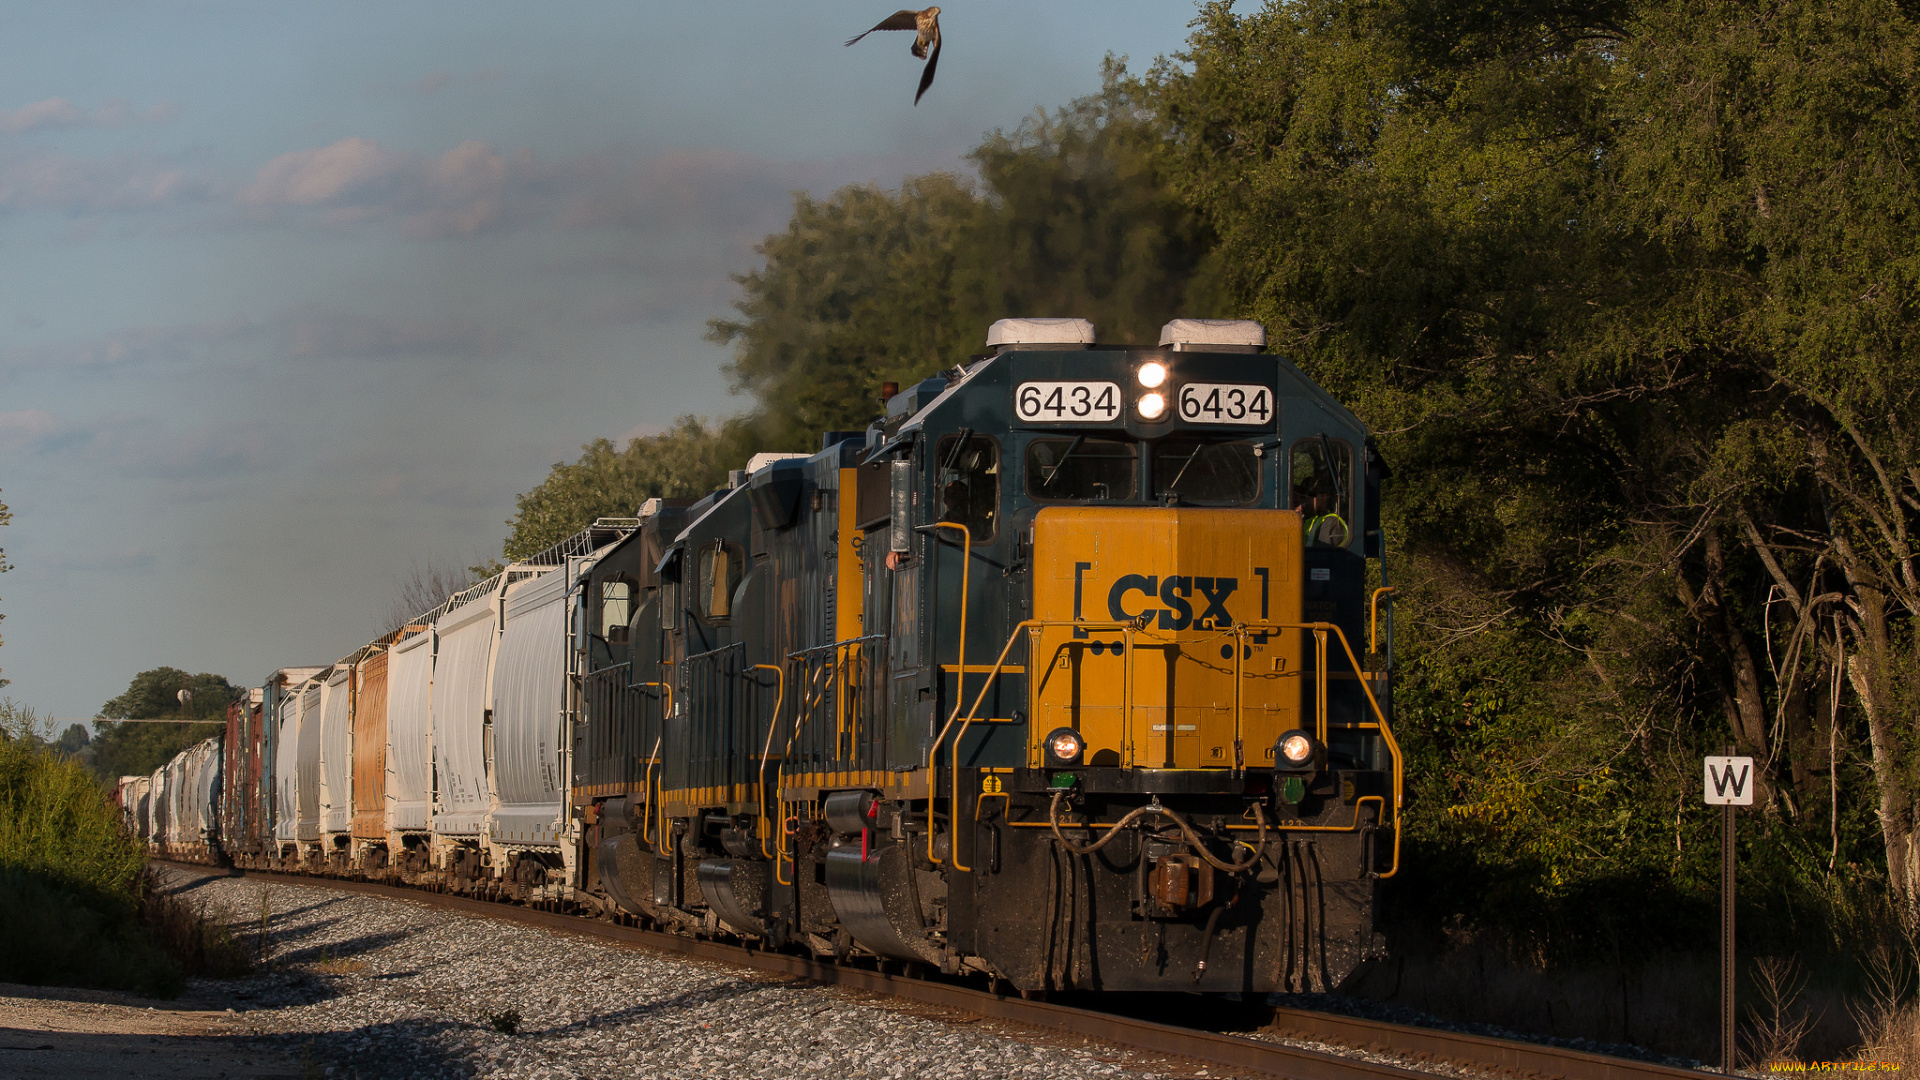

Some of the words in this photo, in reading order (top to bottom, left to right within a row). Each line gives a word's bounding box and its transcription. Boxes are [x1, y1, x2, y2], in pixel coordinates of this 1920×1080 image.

[1020, 386, 1117, 417] 6434
[1181, 387, 1270, 421] 6434
[1108, 574, 1238, 631] CSX
[1709, 764, 1750, 797] W
